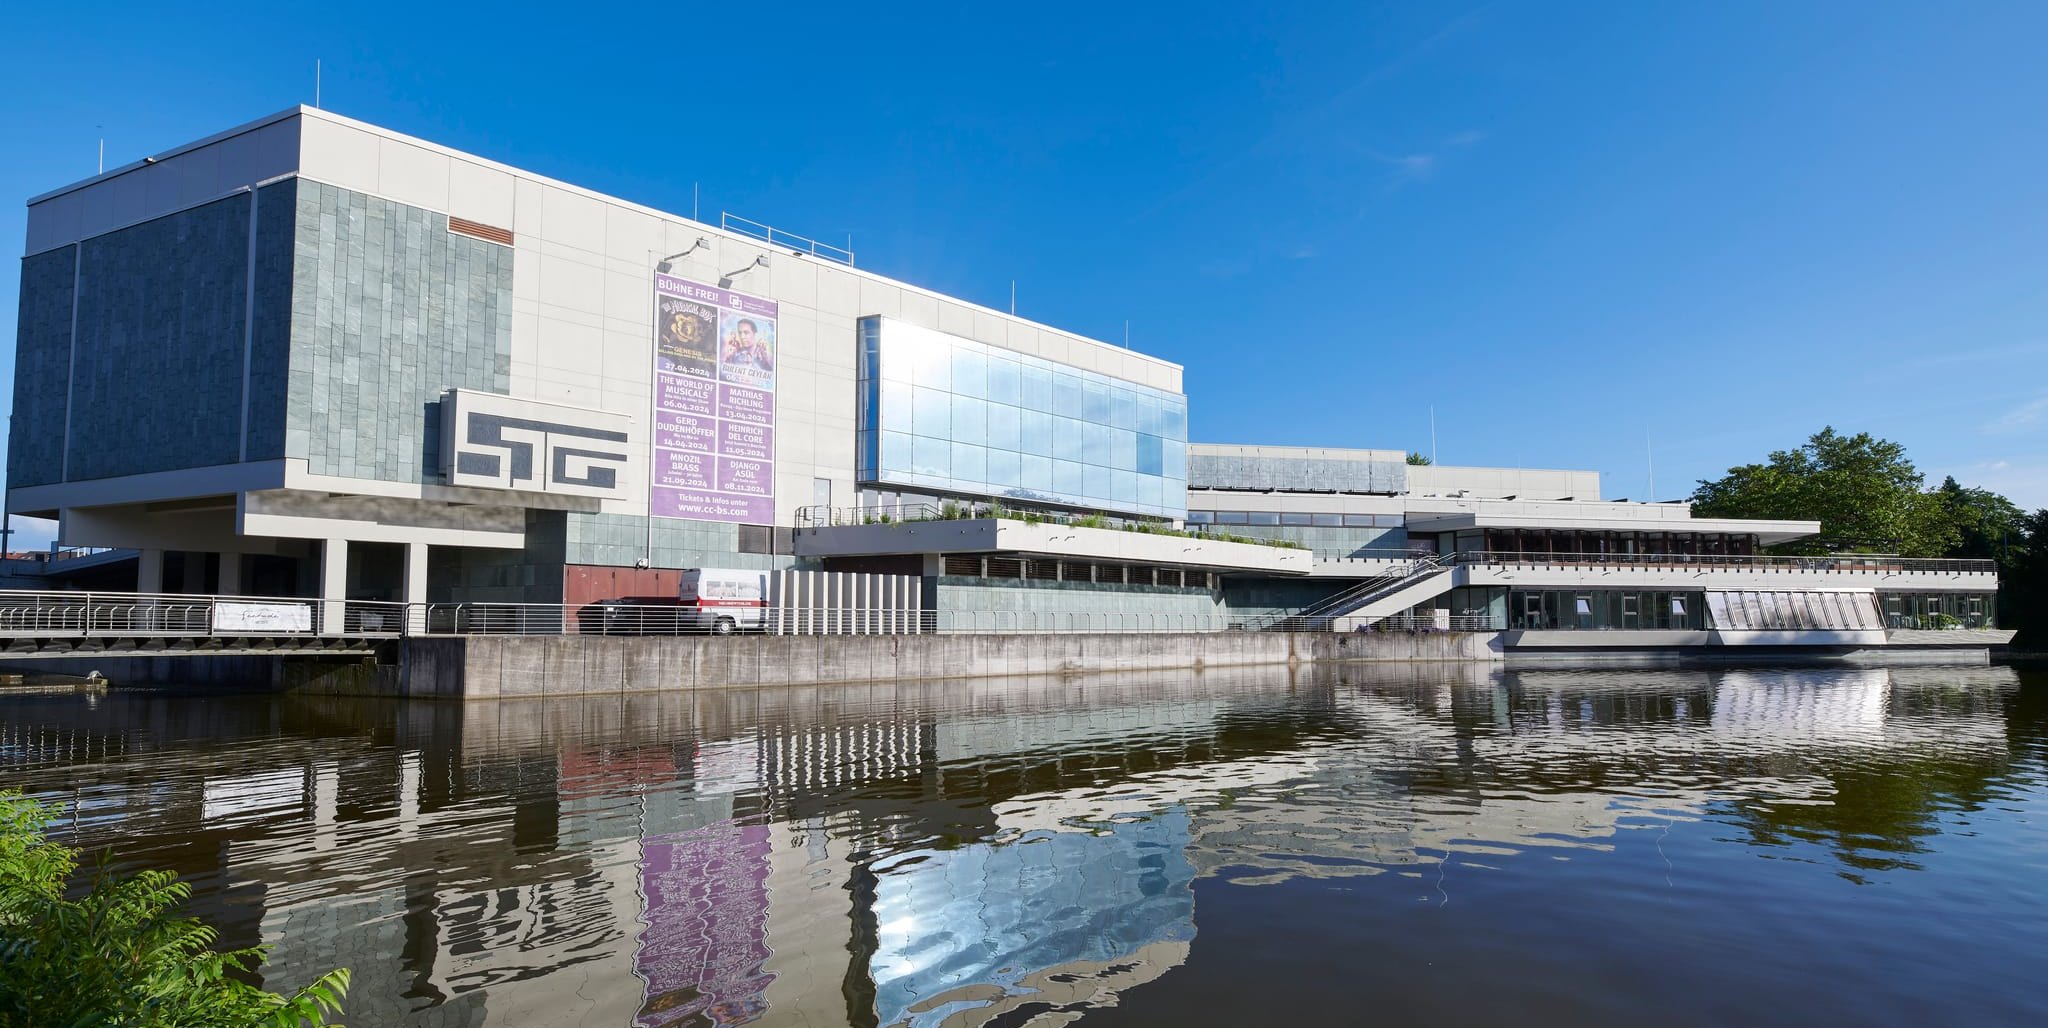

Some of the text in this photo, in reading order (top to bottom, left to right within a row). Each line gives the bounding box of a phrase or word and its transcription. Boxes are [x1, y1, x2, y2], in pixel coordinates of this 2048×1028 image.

[659, 279, 719, 302] BÜHNE FREI!
[665, 363, 709, 377] 27.04.2024
[660, 376, 674, 385] THE
[676, 379, 703, 390] WORLD
[665, 386, 709, 399] MUSICALS
[730, 388, 763, 400] MATHIAS
[664, 399, 709, 414] 06.04.2024
[729, 397, 764, 409] RICHLING
[676, 417, 697, 426] GERD
[726, 410, 766, 423] 13.04.2024
[657, 423, 714, 437] DUDENHÖFFER
[729, 424, 763, 435] HEINRICH
[728, 433, 763, 444] DEL CORE
[664, 438, 708, 451] 14.04.2024
[726, 447, 765, 458] 11.05.2024
[670, 454, 701, 464] MNOZIL
[672, 462, 699, 472] BRASS
[730, 461, 760, 471] DJANGO
[735, 469, 755, 478] ASÜL
[663, 477, 707, 488] 21.09.2024
[725, 483, 765, 494] 08.11.2024
[679, 494, 704, 502] Tickets
[712, 497, 729, 505] Infos
[678, 503, 748, 516] www.cc-bs.com
